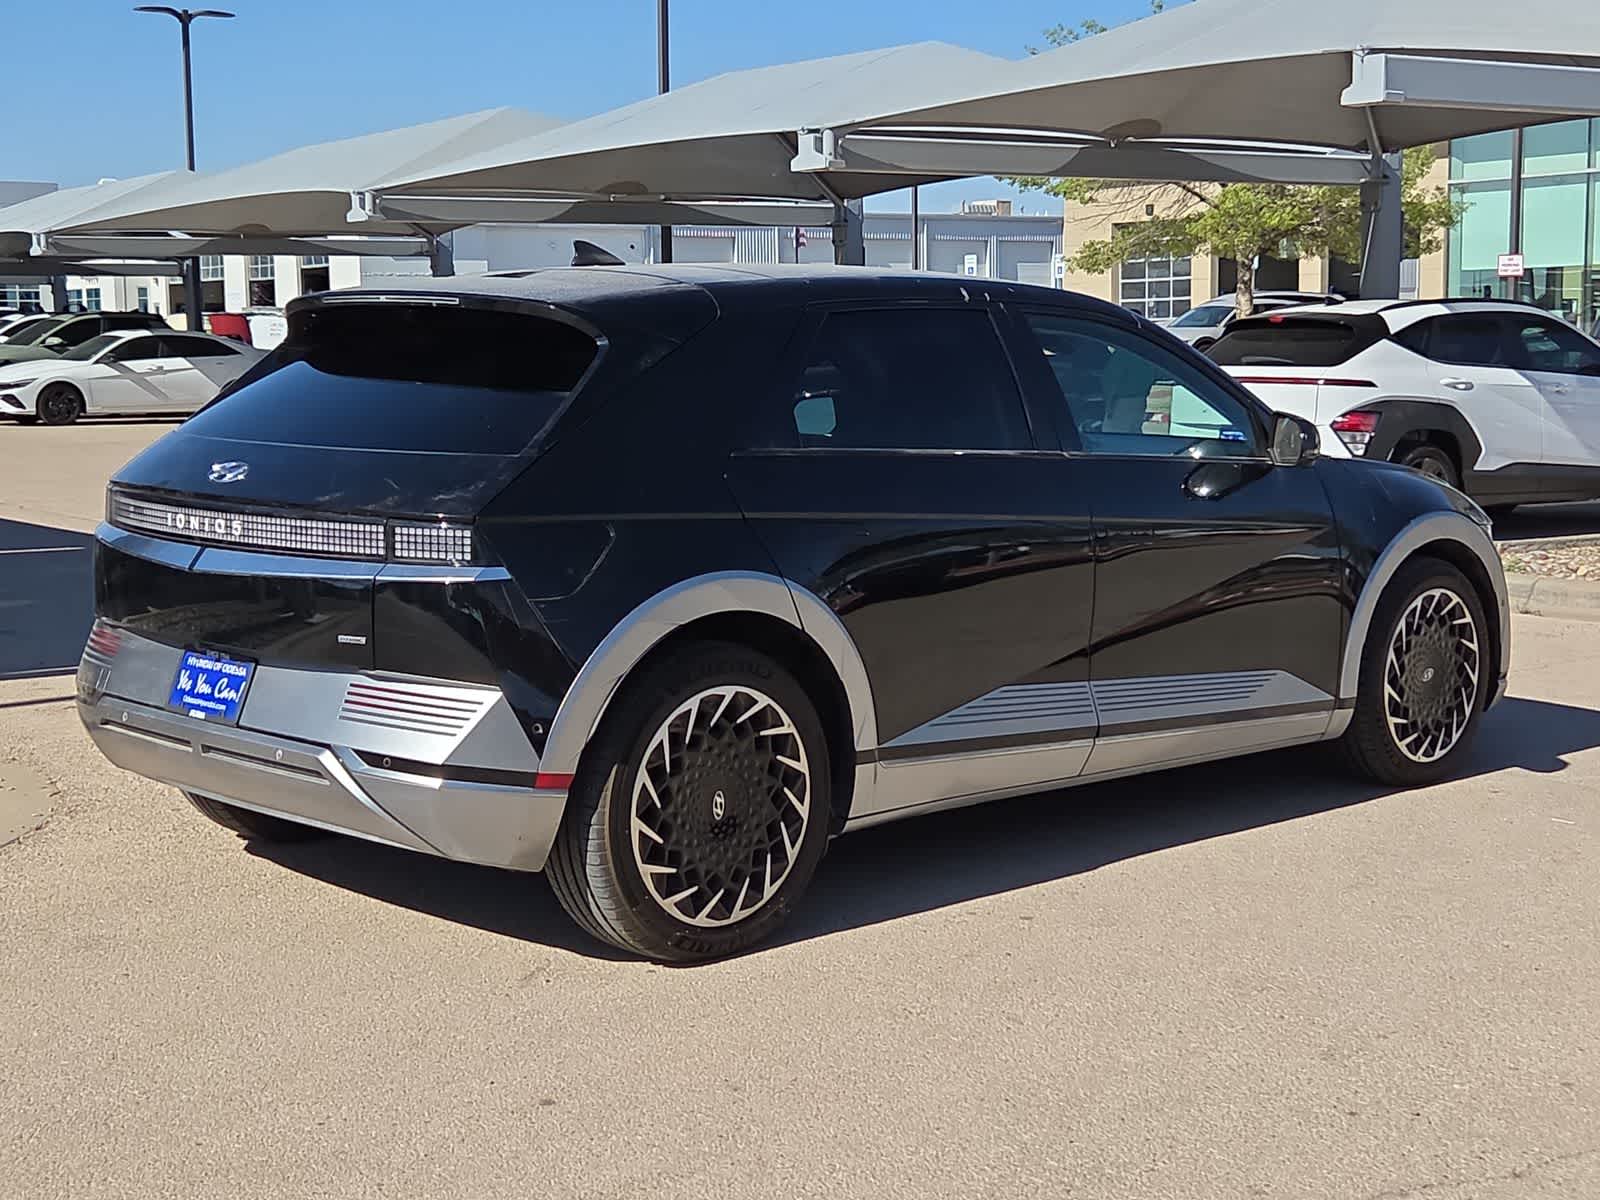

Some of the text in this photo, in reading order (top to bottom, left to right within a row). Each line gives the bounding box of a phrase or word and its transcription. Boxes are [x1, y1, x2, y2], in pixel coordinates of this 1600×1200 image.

[187, 656, 214, 670] HYUNDAI
[213, 661, 222, 671] OF
[177, 669, 246, 703] Yes You Can!
